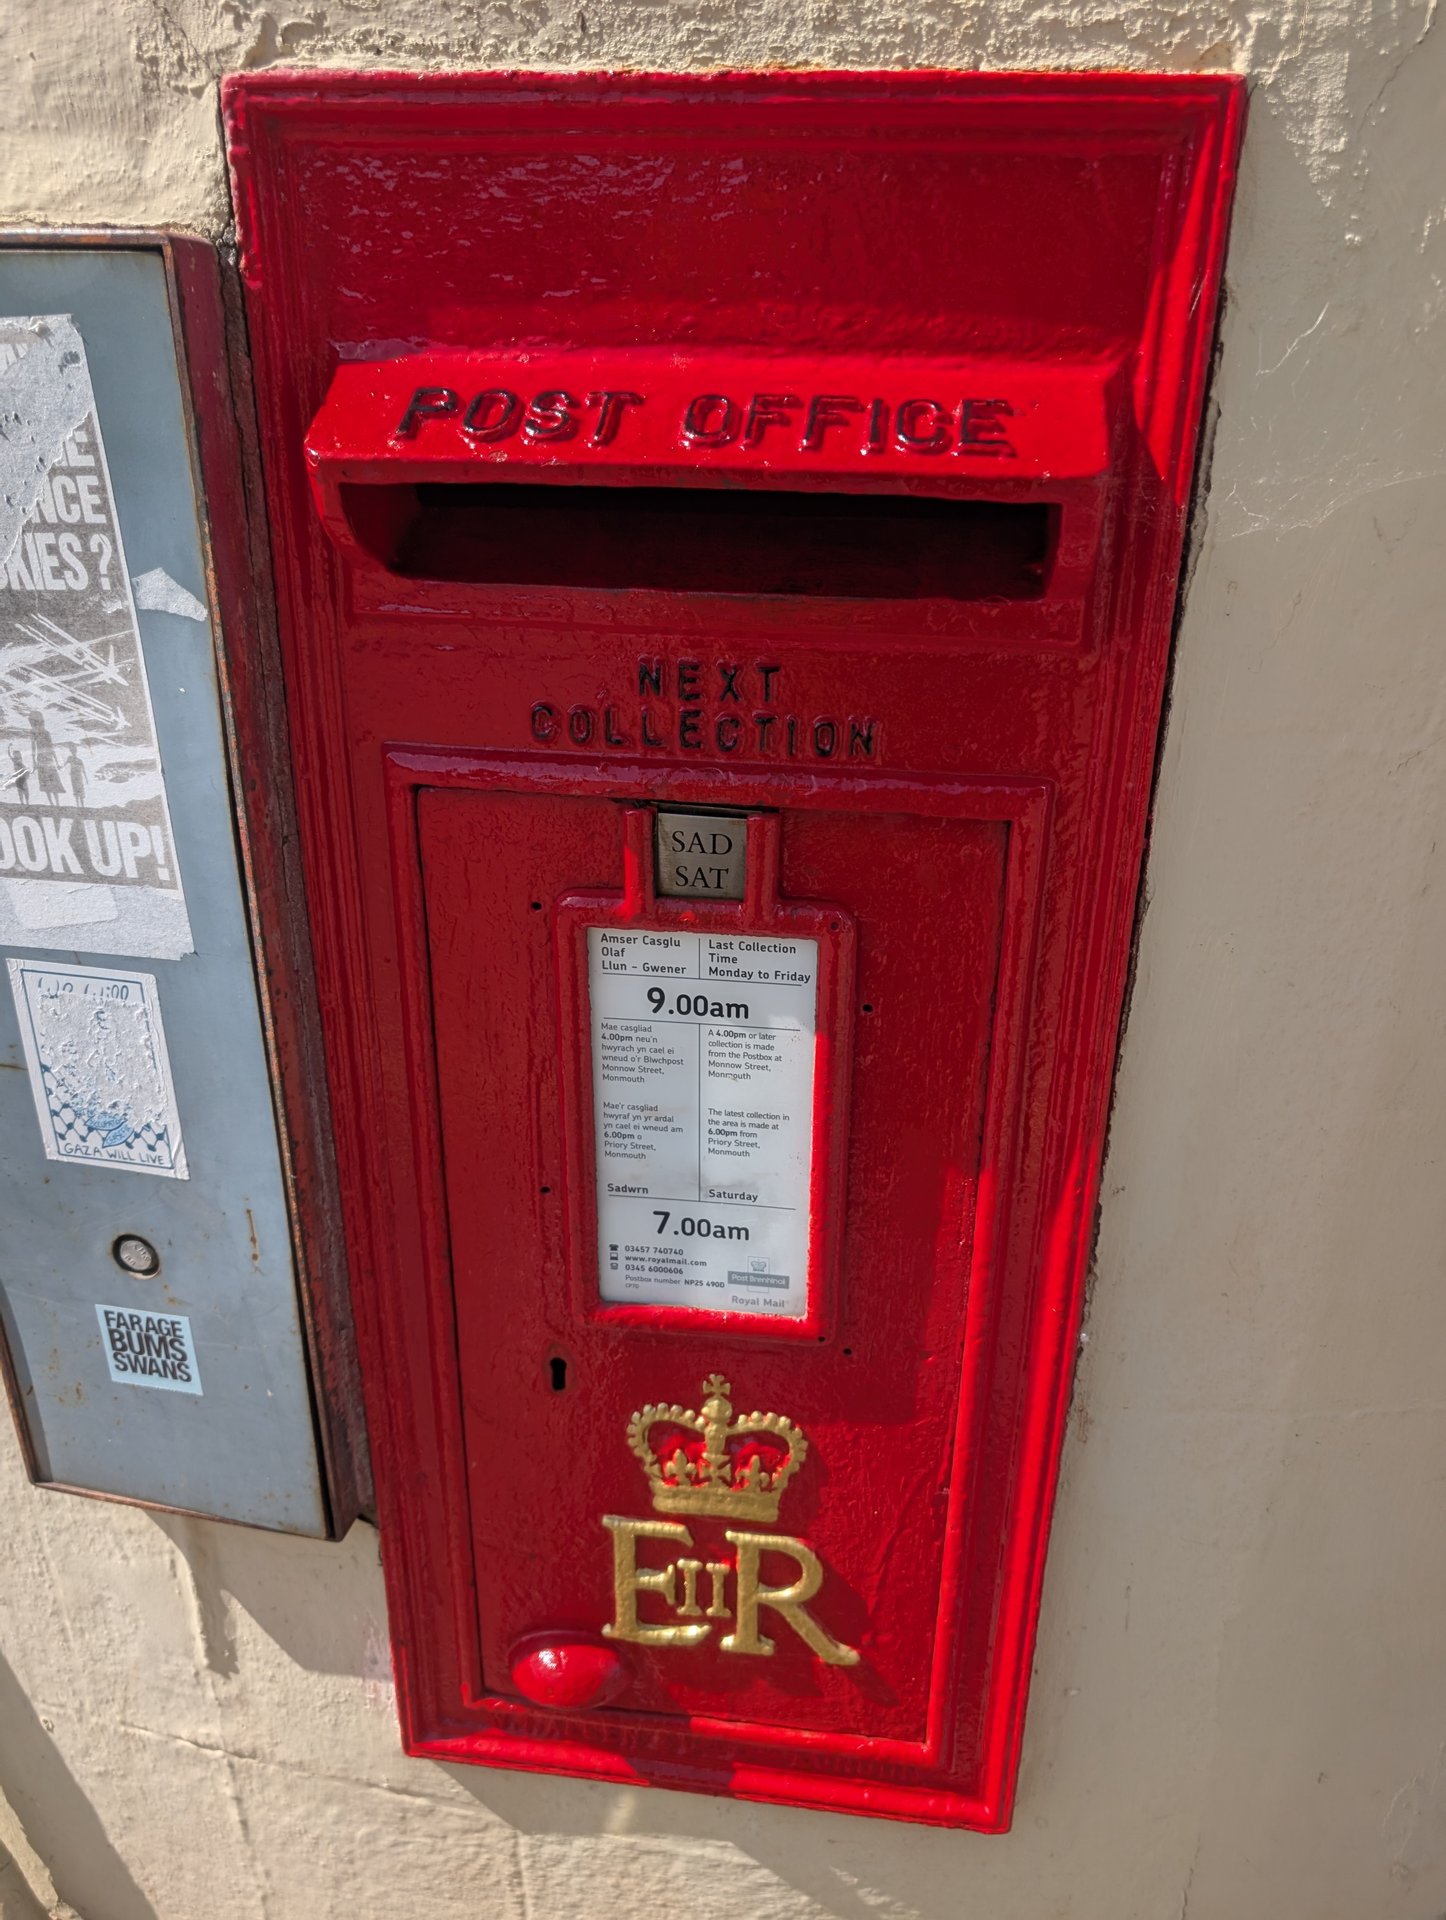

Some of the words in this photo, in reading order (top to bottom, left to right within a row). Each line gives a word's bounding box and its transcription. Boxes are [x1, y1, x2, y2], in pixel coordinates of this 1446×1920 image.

[395, 386, 646, 447] POST
[678, 393, 1017, 457] OFFICE
[0, 532, 112, 591] KIES?
[638, 660, 781, 703] NEXT
[530, 703, 876, 757] COLLECTION
[671, 830, 733, 856] SAD
[85, 819, 171, 881] UP!
[674, 865, 729, 890] SAT
[600, 933, 639, 945] Amser
[642, 935, 681, 948] Casglu
[708, 939, 734, 951] Last
[738, 941, 797, 954] Collection
[601, 947, 626, 958] Olaf
[708, 953, 738, 964] Time
[602, 960, 627, 971] Llun
[642, 962, 687, 975] Gwener
[708, 966, 754, 980] Monday
[758, 969, 770, 980] to
[774, 970, 811, 984] Friday
[647, 986, 749, 1019] 9.00am
[601, 1022, 618, 1031] Mae
[620, 1025, 652, 1033] casgliad
[601, 1033, 633, 1042] 4.00pm
[716, 1030, 747, 1039] 4.00pm
[759, 1032, 776, 1041] later
[602, 1043, 634, 1052] hwyrach
[649, 1046, 665, 1054] cael
[708, 1041, 743, 1049] collection
[753, 1043, 775, 1051] made
[643, 1055, 684, 1066] Blwchpost
[708, 1050, 726, 1058] from
[728, 1051, 741, 1059] the
[743, 1051, 772, 1061] Postbox
[602, 1063, 636, 1072] Monnow
[638, 1065, 665, 1075] Street,
[708, 1060, 742, 1069] Monnow
[744, 1062, 771, 1072] Street,
[602, 1074, 645, 1083] Monmouth
[627, 1104, 658, 1112] casgliad
[603, 1112, 630, 1121] hwyraf
[632, 1114, 642, 1122] yn
[654, 1115, 674, 1123] ardal
[708, 1108, 722, 1116] The
[724, 1109, 745, 1118] latest
[746, 1111, 780, 1120] collection
[782, 1113, 790, 1121] in
[615, 1122, 631, 1130] cael
[708, 1118, 720, 1126] the
[741, 1120, 746, 1128] is
[604, 1131, 635, 1140] 6.00pm
[708, 1128, 738, 1137] 6.00pm
[739, 1130, 758, 1138] from
[604, 1141, 628, 1150] Priory
[630, 1142, 656, 1151] Street,
[708, 1137, 732, 1147] Priory
[734, 1139, 760, 1149] Street,
[64, 1143, 103, 1157] GAZA
[106, 1150, 137, 1161] WILL
[139, 1152, 165, 1165] LIVE
[604, 1150, 646, 1159] Monmouth
[708, 1147, 750, 1157] Monmouth
[607, 1184, 649, 1195] Sadwrn
[709, 1189, 758, 1202] Saturday
[653, 1211, 750, 1241] 7.00am
[625, 1245, 650, 1253] 03457
[653, 1247, 684, 1256] 740740
[625, 1255, 707, 1266] www.royalmail.com
[625, 1274, 652, 1283] Postbox
[732, 1295, 760, 1306] Royal
[763, 1298, 785, 1308] Mail
[104, 1310, 184, 1339] FARAGE
[108, 1327, 188, 1362] BUMS
[113, 1351, 192, 1383] SWANS
